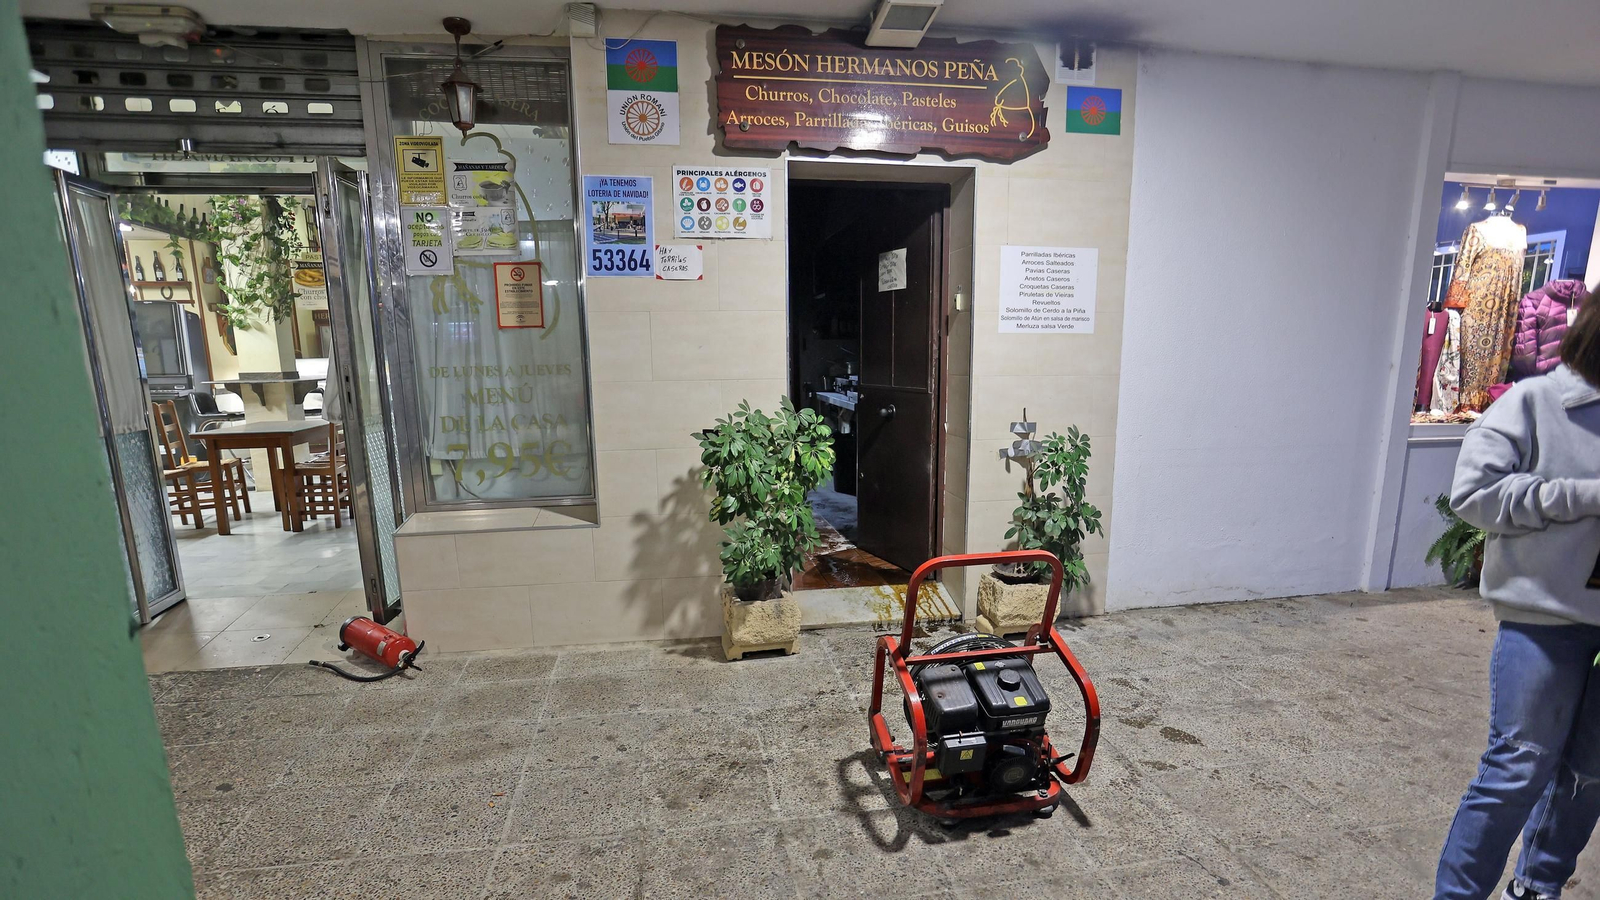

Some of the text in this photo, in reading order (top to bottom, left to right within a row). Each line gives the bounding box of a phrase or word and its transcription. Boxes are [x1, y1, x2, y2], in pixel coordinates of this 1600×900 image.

[730, 48, 999, 81] MESÓN HERMANOS PEÑA
[745, 84, 957, 109] Churros, Chocolate, Pasteles
[726, 110, 990, 135] Arroces, Parrillada béricas, Guisos
[610, 178, 637, 187] TENEMOS
[676, 169, 767, 178] PRINCIPALES ALÉRGENOS
[613, 190, 621, 198] DE
[622, 190, 649, 199] NAVIDAD!
[415, 212, 434, 223] NO
[412, 239, 443, 247] TARJETA
[592, 248, 651, 272] 53364
[429, 363, 572, 379] DE LUNES A JUEVES
[464, 383, 533, 405] MENÚ
[440, 412, 568, 434] DE LA CASA
[446, 439, 572, 487] 7,95€
[1002, 717, 1038, 727] VANGUARD
